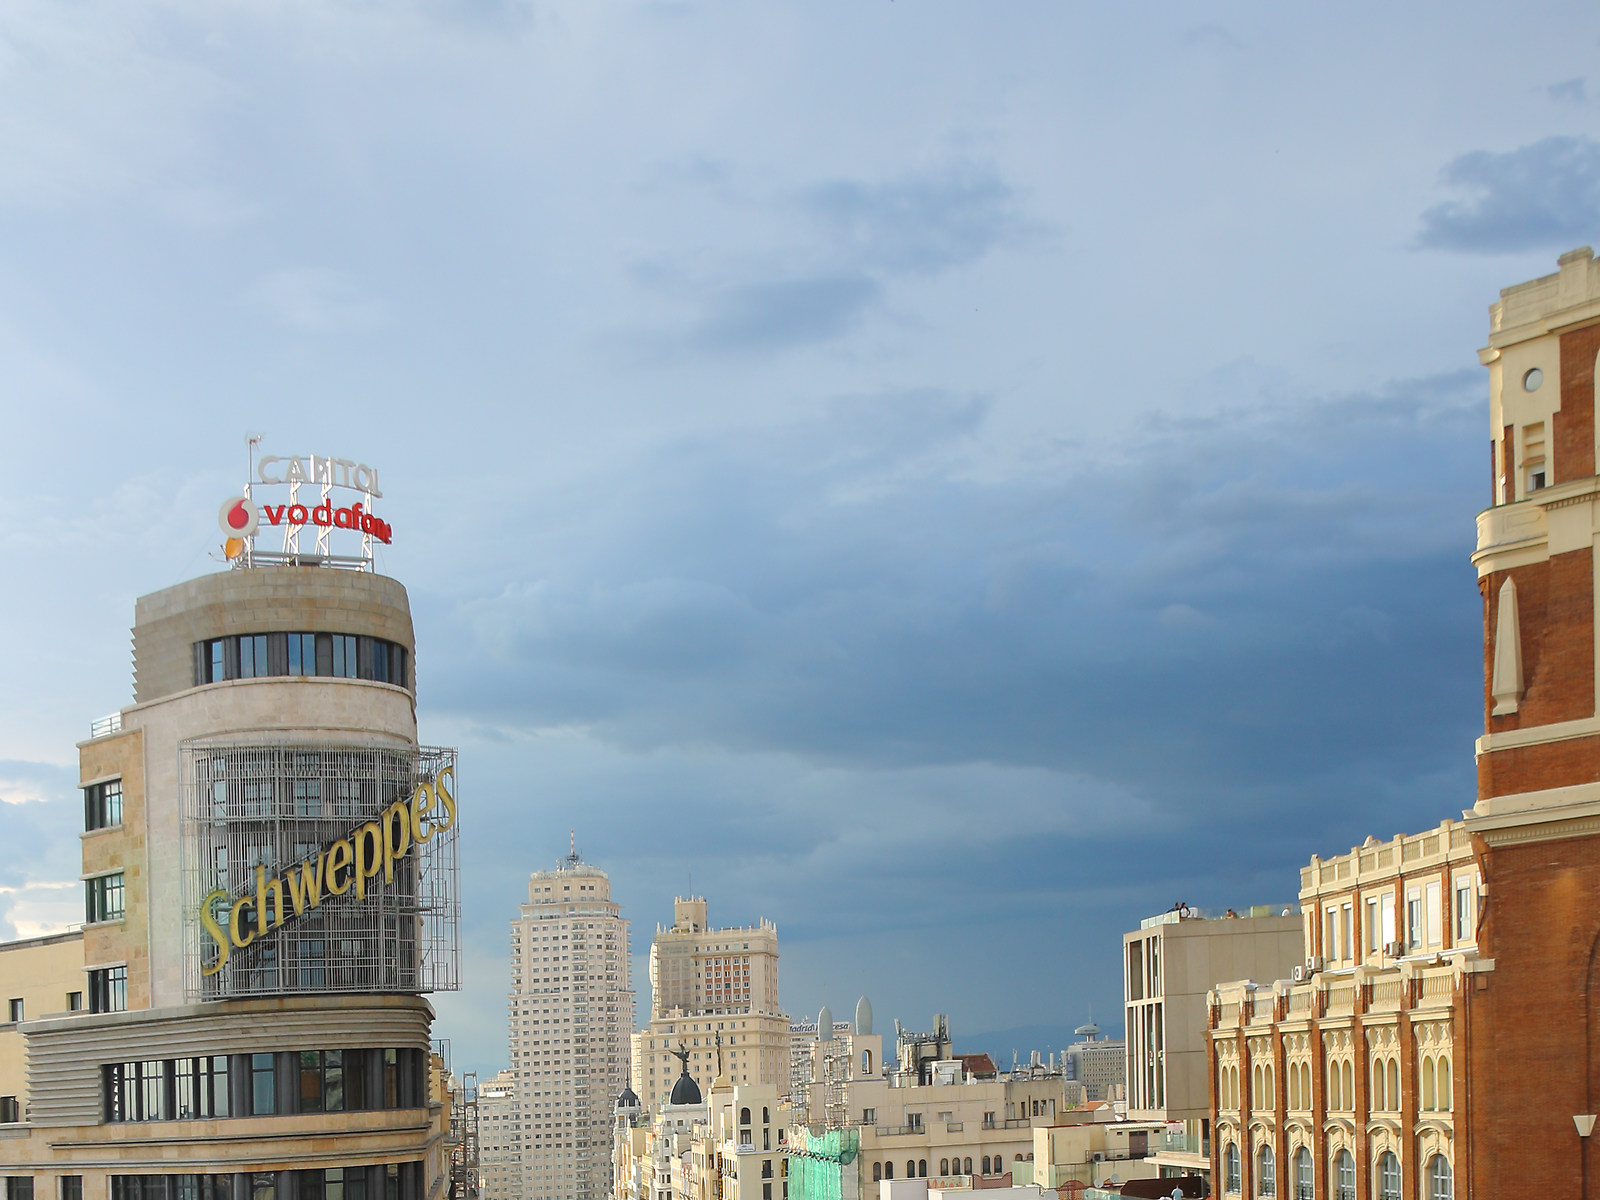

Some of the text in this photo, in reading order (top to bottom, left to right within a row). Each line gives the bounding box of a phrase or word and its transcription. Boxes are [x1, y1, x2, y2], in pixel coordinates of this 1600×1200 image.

[258, 454, 382, 498] CAPITOL
[264, 498, 392, 544] vodafone
[200, 765, 456, 976] Schweppes
